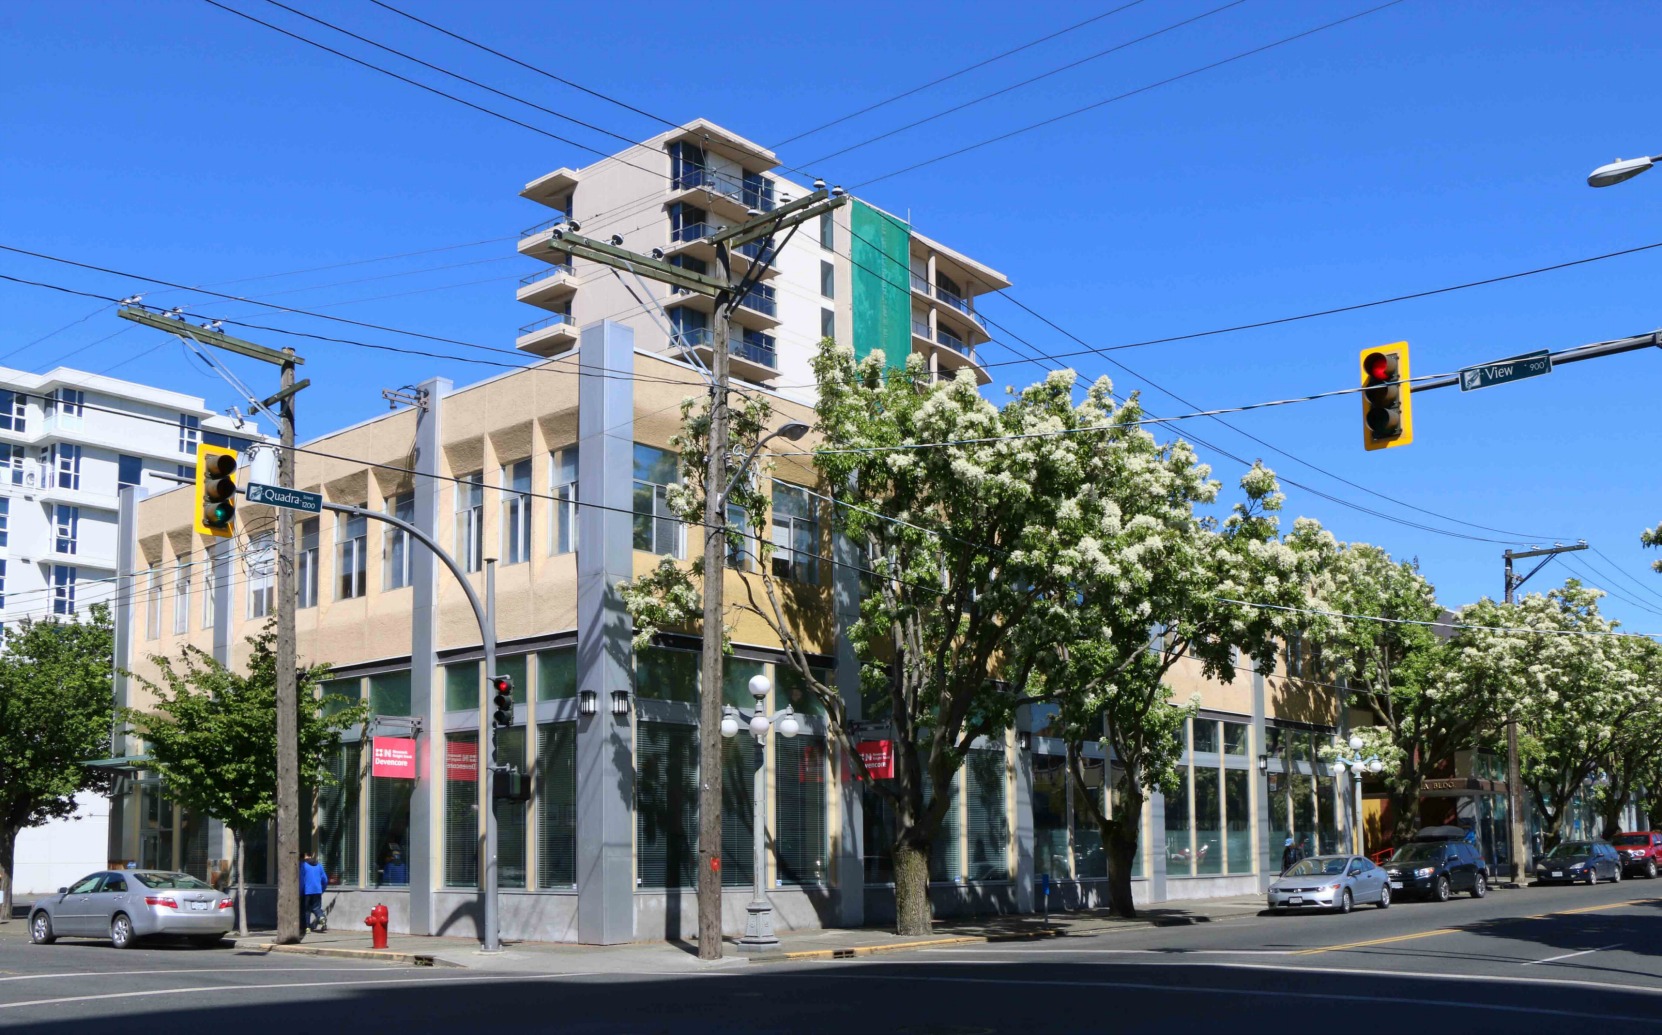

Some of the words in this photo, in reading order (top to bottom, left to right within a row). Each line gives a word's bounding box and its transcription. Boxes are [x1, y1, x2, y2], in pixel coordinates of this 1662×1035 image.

[1485, 366, 1513, 380] View
[1530, 362, 1544, 372] 900
[264, 489, 300, 504] Quadra
[375, 757, 408, 766] Devencore
